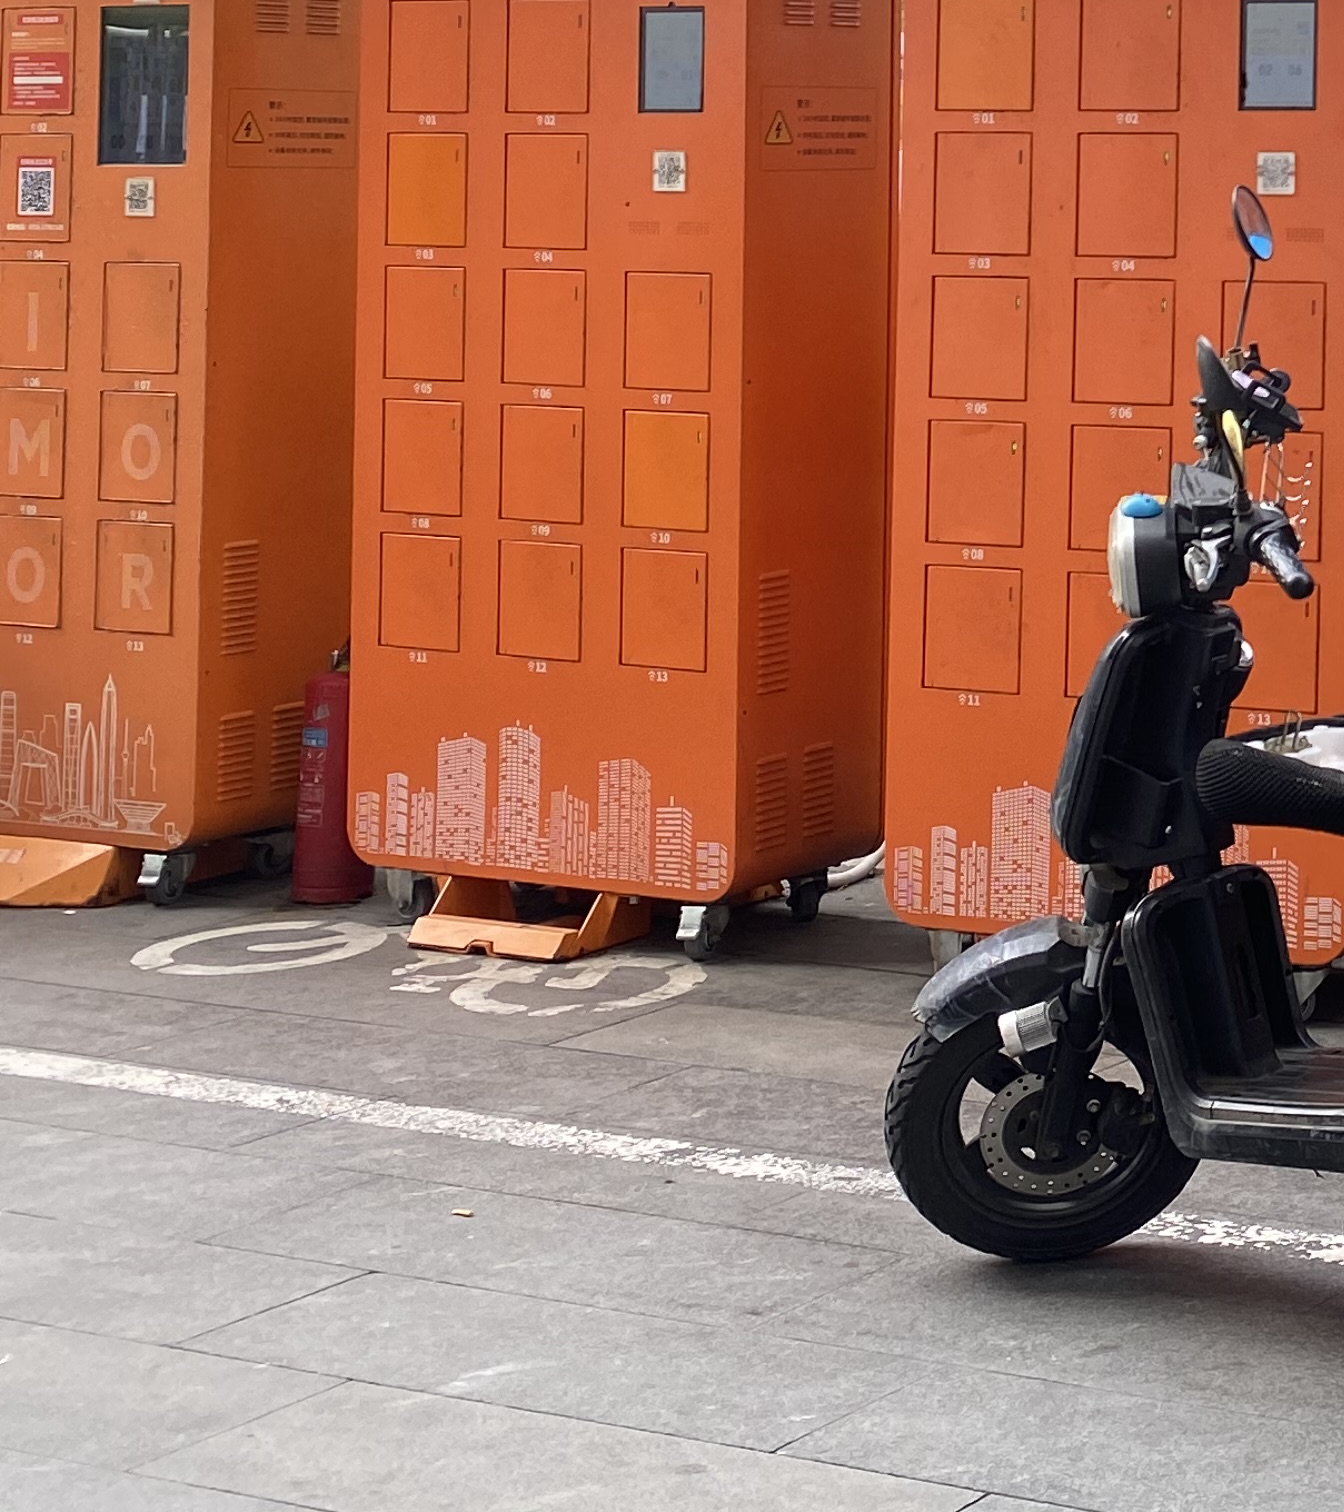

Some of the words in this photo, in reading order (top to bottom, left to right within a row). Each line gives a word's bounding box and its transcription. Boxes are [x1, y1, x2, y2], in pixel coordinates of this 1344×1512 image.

[424, 114, 437, 126] 01
[542, 114, 556, 126] 02
[981, 113, 995, 125] 01
[1124, 113, 1139, 125] 02
[421, 248, 434, 260] 03
[540, 251, 553, 263] 04
[976, 257, 991, 269] 03
[1120, 260, 1135, 272] 04
[419, 383, 432, 394] 05
[539, 387, 553, 399] 06
[658, 393, 672, 405] 07
[973, 402, 988, 414] 05
[1117, 407, 1133, 419] 06
[8, 418, 50, 478] M
[120, 423, 161, 480] O
[417, 517, 430, 528] 08
[537, 524, 551, 536] 09
[657, 532, 671, 544] 10
[969, 549, 985, 561] 08
[7, 546, 46, 604] O
[121, 553, 154, 611] R
[415, 651, 427, 663] 11
[534, 661, 548, 673] 12
[655, 671, 668, 682] 13
[967, 694, 981, 706] 11
[1256, 714, 1271, 726] 13
